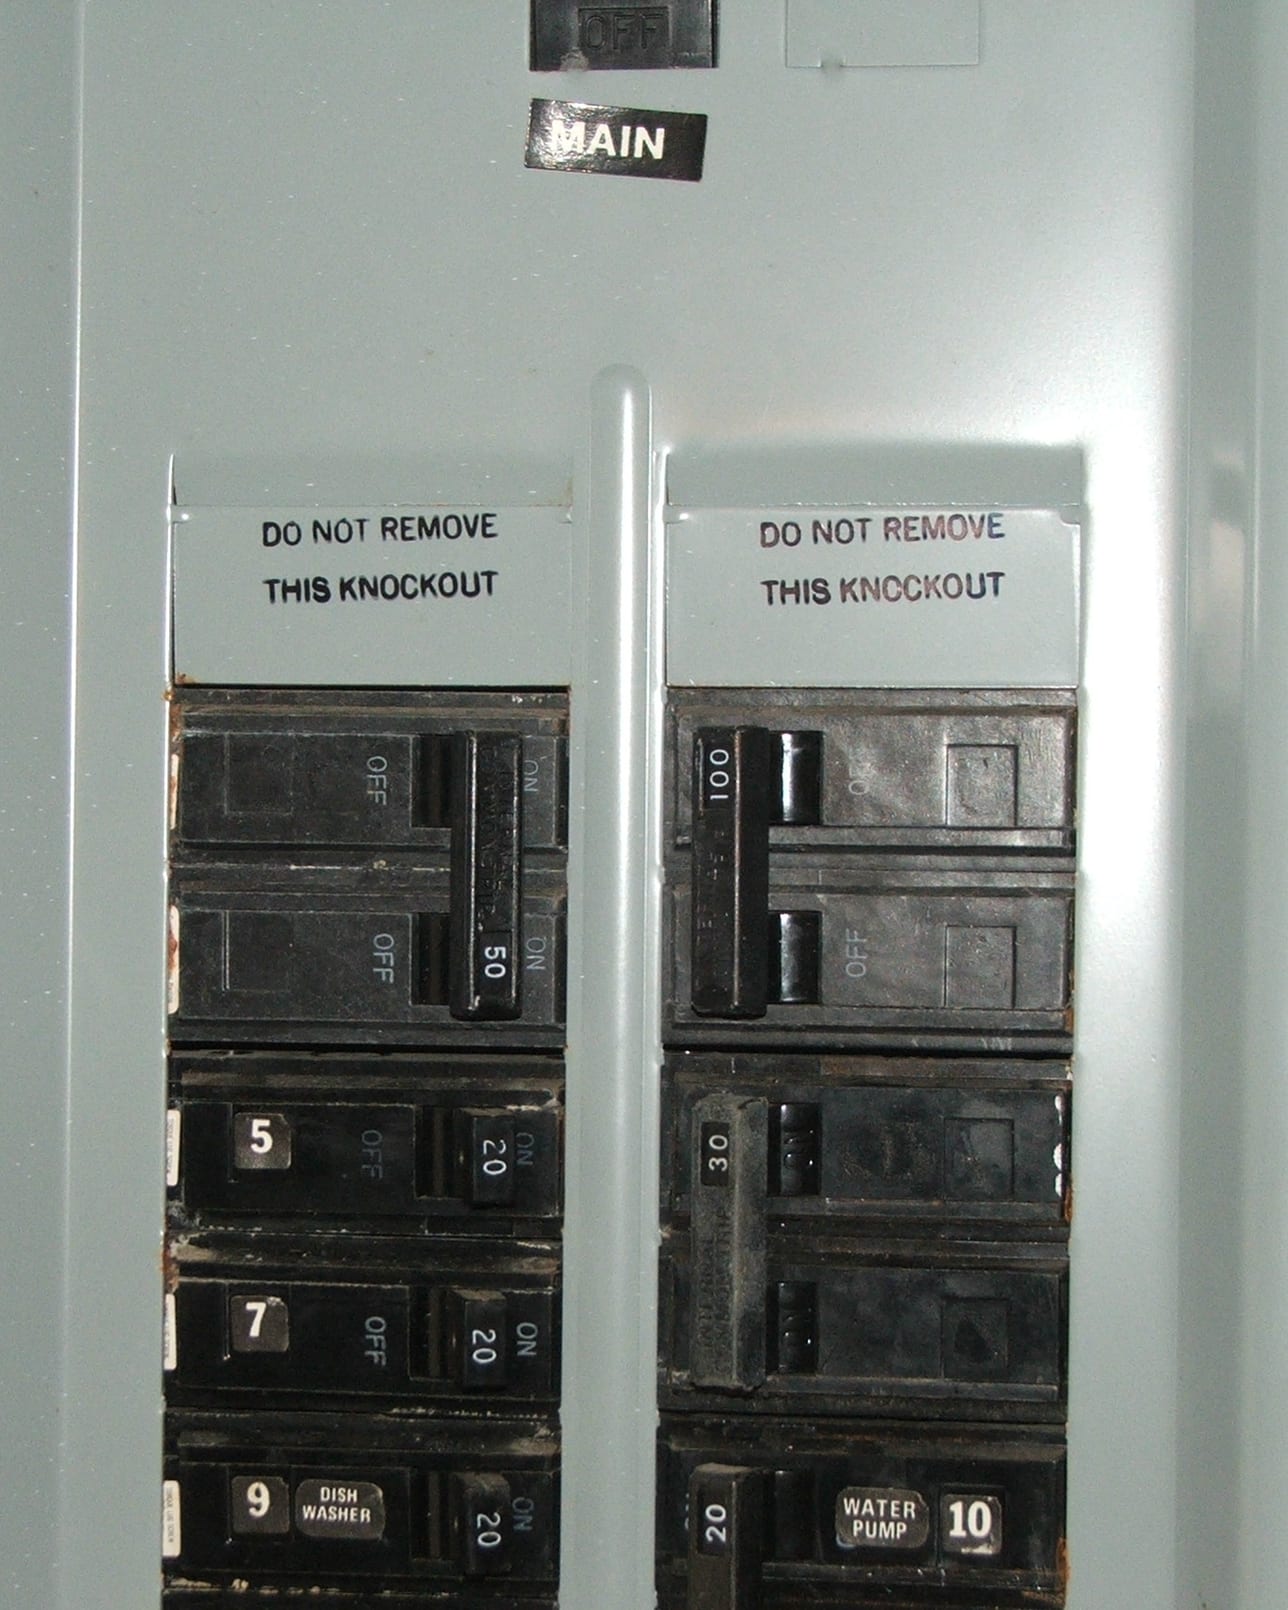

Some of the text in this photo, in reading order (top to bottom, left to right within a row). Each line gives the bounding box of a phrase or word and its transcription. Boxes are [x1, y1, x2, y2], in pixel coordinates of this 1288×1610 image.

[583, 13, 663, 50] OFF
[551, 119, 665, 160] MAIN
[262, 513, 498, 547] DO NOT REMOVE
[760, 513, 1005, 547] DO NOT REMOVE
[263, 570, 499, 604] THIS KNOCKOUT
[761, 572, 1005, 605] THIS KNOCKOUT
[366, 755, 388, 805] OFF
[523, 759, 539, 792] ON
[709, 749, 729, 800] 100
[373, 933, 395, 984] OFF
[484, 946, 506, 978] 50
[525, 937, 546, 971] ON
[845, 928, 867, 978] OFF
[251, 1119, 273, 1154] 5
[516, 1131, 535, 1166] ON
[708, 1134, 728, 1171] 30
[361, 1129, 383, 1180] OFF
[483, 1139, 507, 1175] 20
[245, 1302, 267, 1337] 7
[364, 1316, 386, 1367] OFF
[472, 1329, 497, 1364] 20
[516, 1322, 538, 1357] ON
[247, 1481, 271, 1518] 9
[320, 1486, 358, 1503] DISH
[843, 1498, 917, 1519] WATER
[302, 1505, 371, 1523] WASHER
[476, 1512, 501, 1547] 20
[512, 1496, 534, 1532] ON
[705, 1503, 727, 1543] 20
[853, 1520, 907, 1540] PUMP
[949, 1500, 992, 1538] 10
